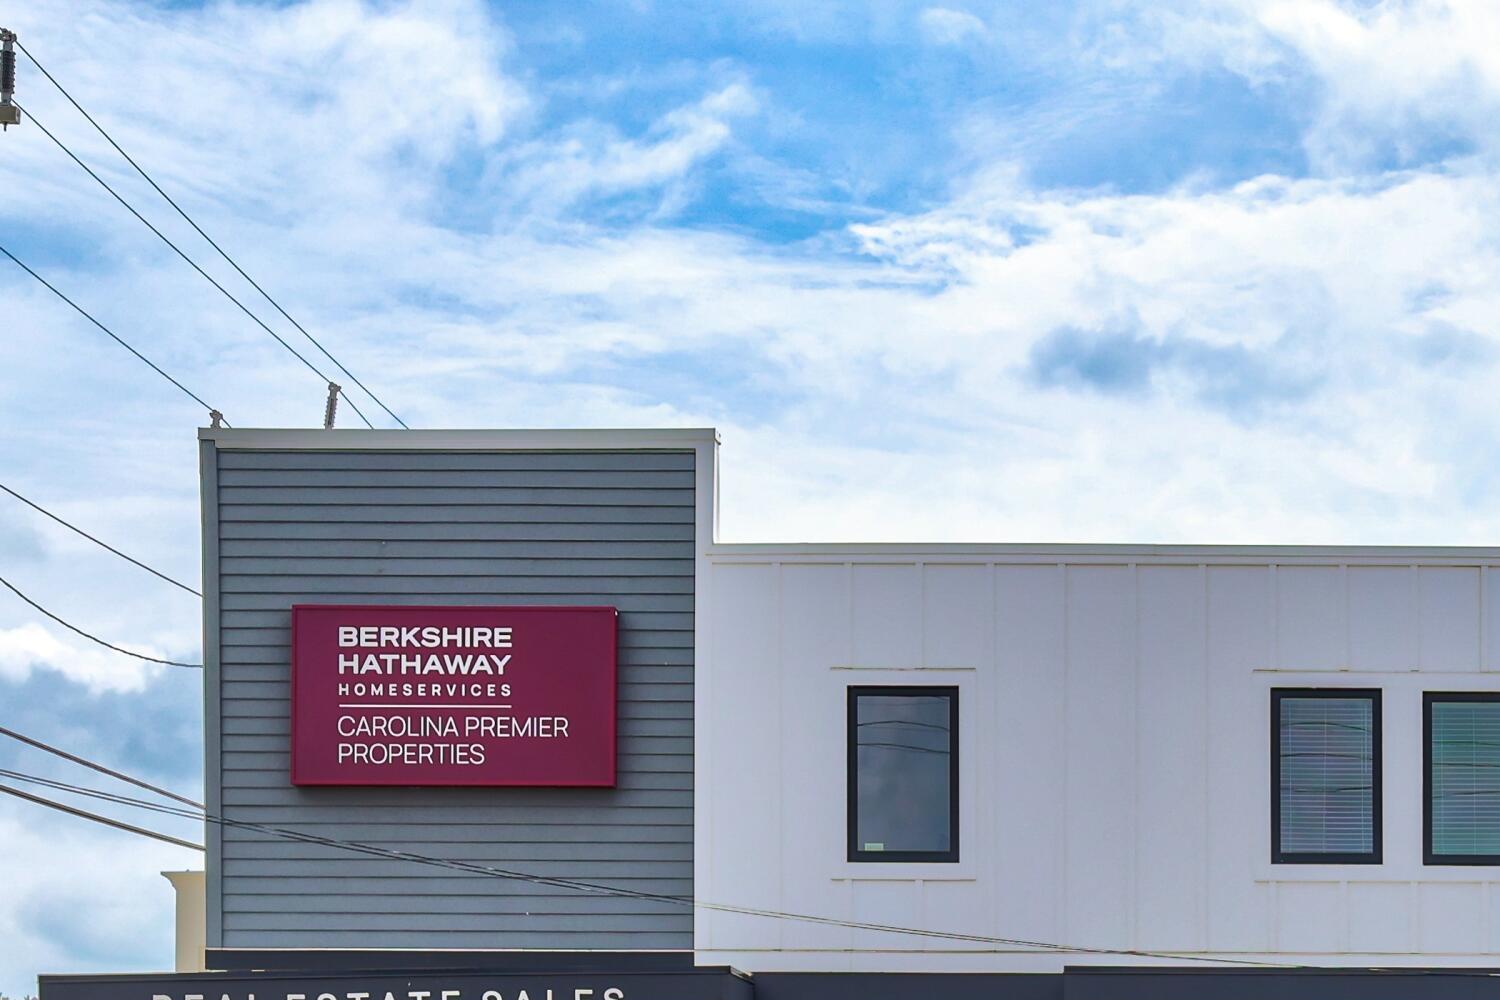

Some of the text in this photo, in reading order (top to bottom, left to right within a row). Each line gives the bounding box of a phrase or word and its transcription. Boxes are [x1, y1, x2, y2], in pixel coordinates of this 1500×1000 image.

[338, 626, 513, 648] BERKSHIRE
[338, 654, 512, 675] HATHAWAY
[338, 683, 512, 697] HOMESERVICES
[337, 715, 569, 738] CAROLINA PREMIER
[338, 743, 485, 765] PROPERTIES
